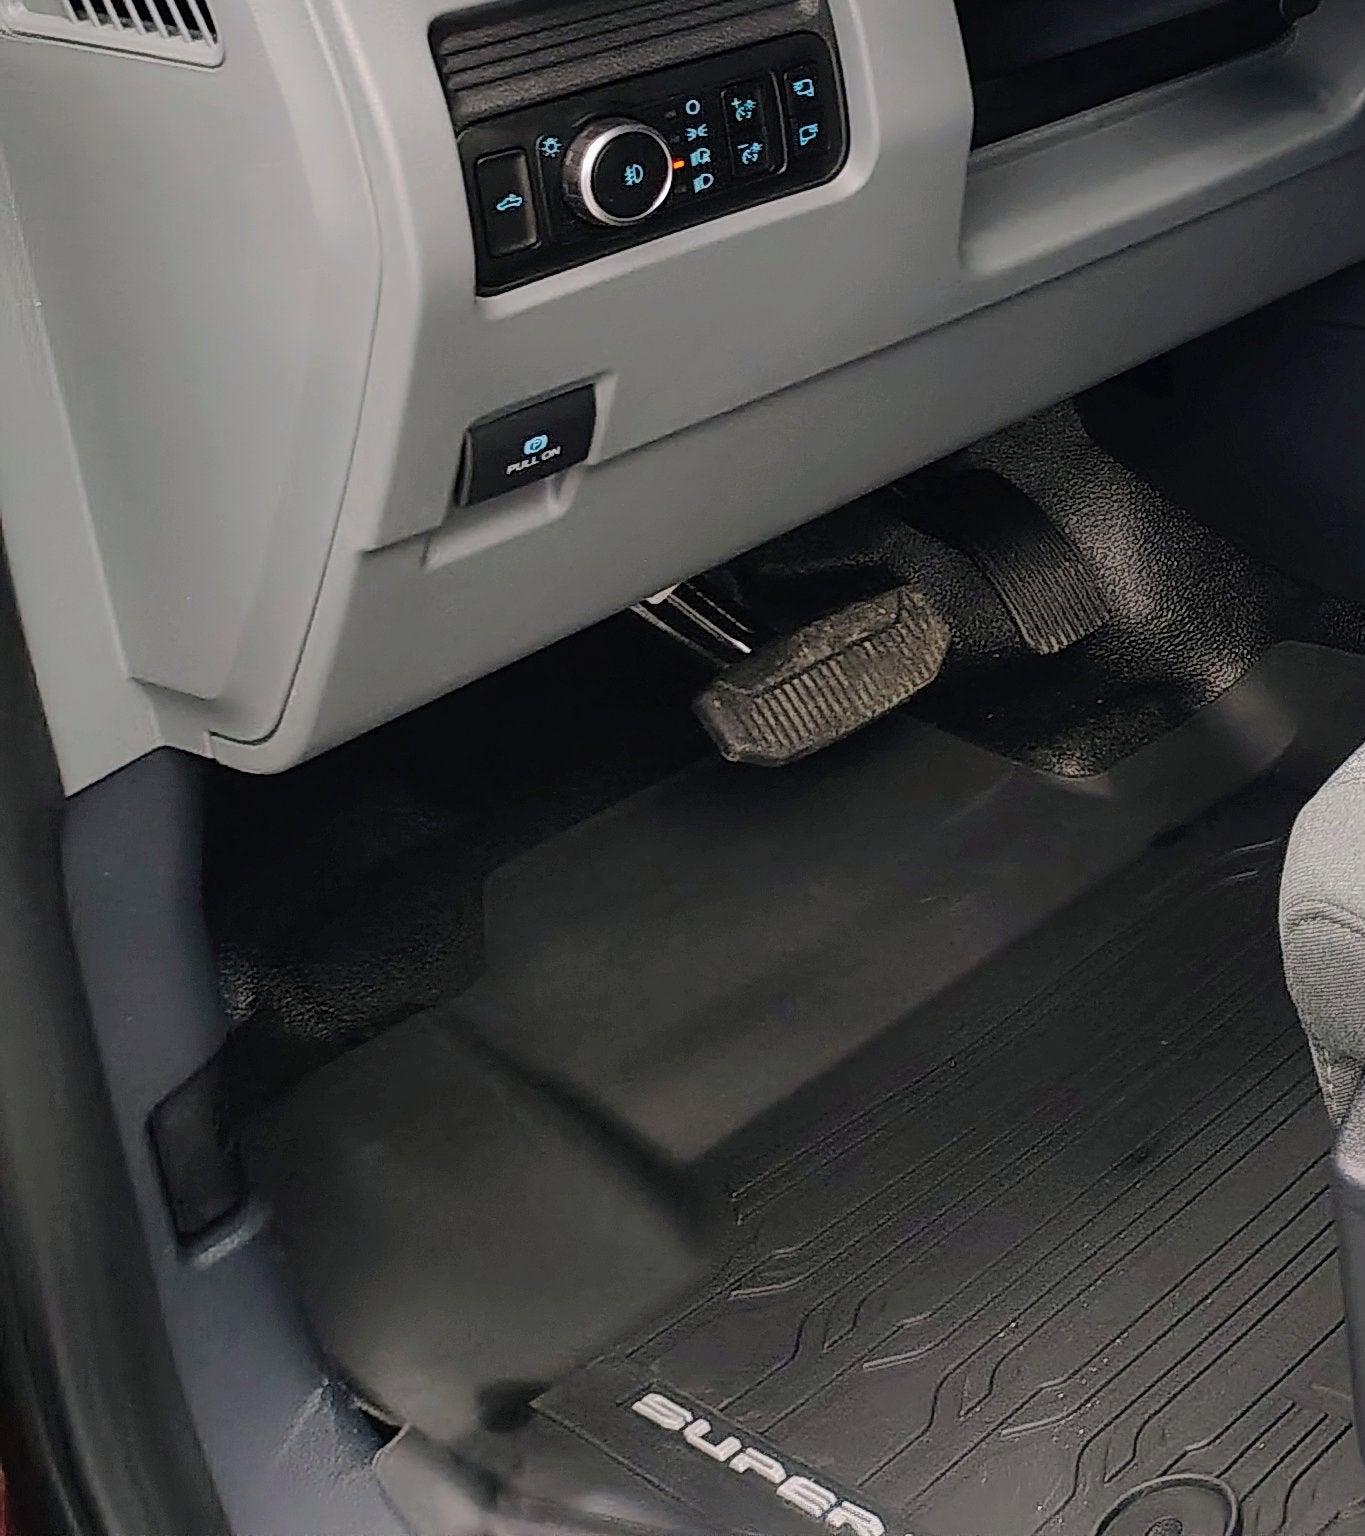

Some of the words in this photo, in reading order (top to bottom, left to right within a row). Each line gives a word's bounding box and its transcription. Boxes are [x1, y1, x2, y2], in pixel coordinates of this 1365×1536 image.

[506, 456, 540, 475] PULL
[541, 445, 561, 461] ON
[632, 1392, 887, 1536] SUPER
